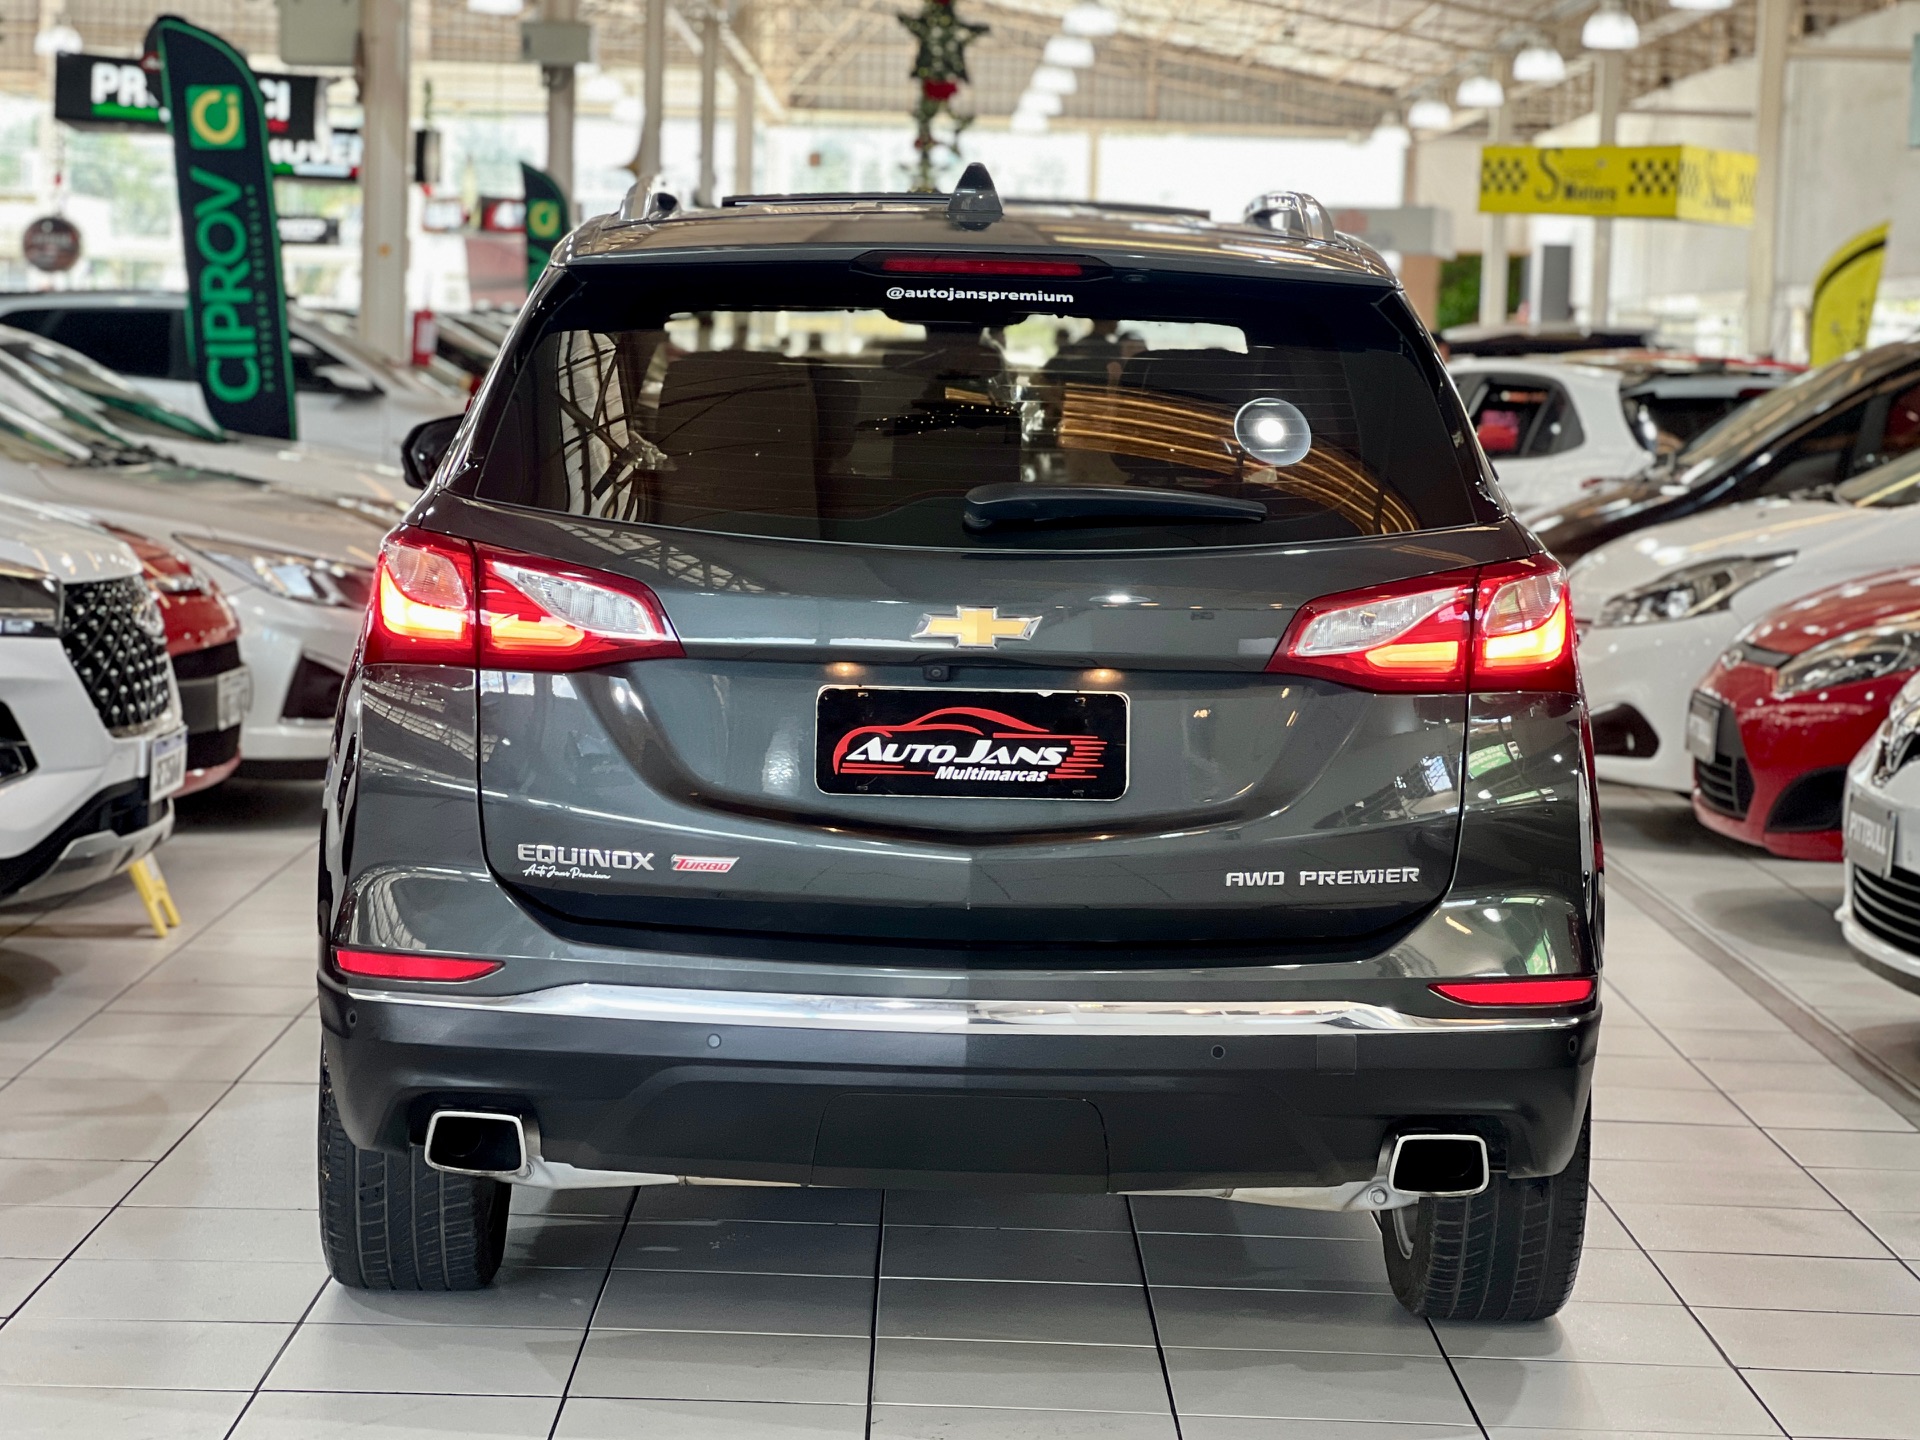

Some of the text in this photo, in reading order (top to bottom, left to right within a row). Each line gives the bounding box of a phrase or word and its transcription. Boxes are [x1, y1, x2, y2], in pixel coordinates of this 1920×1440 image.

[189, 165, 262, 404] CIPROV
[886, 287, 1075, 303] @autojanspremium
[934, 766, 1049, 783] Multimarcas
[517, 843, 656, 871] EQUINOX
[672, 855, 733, 873] TURBO
[1225, 867, 1420, 887] AWD PREMIER
